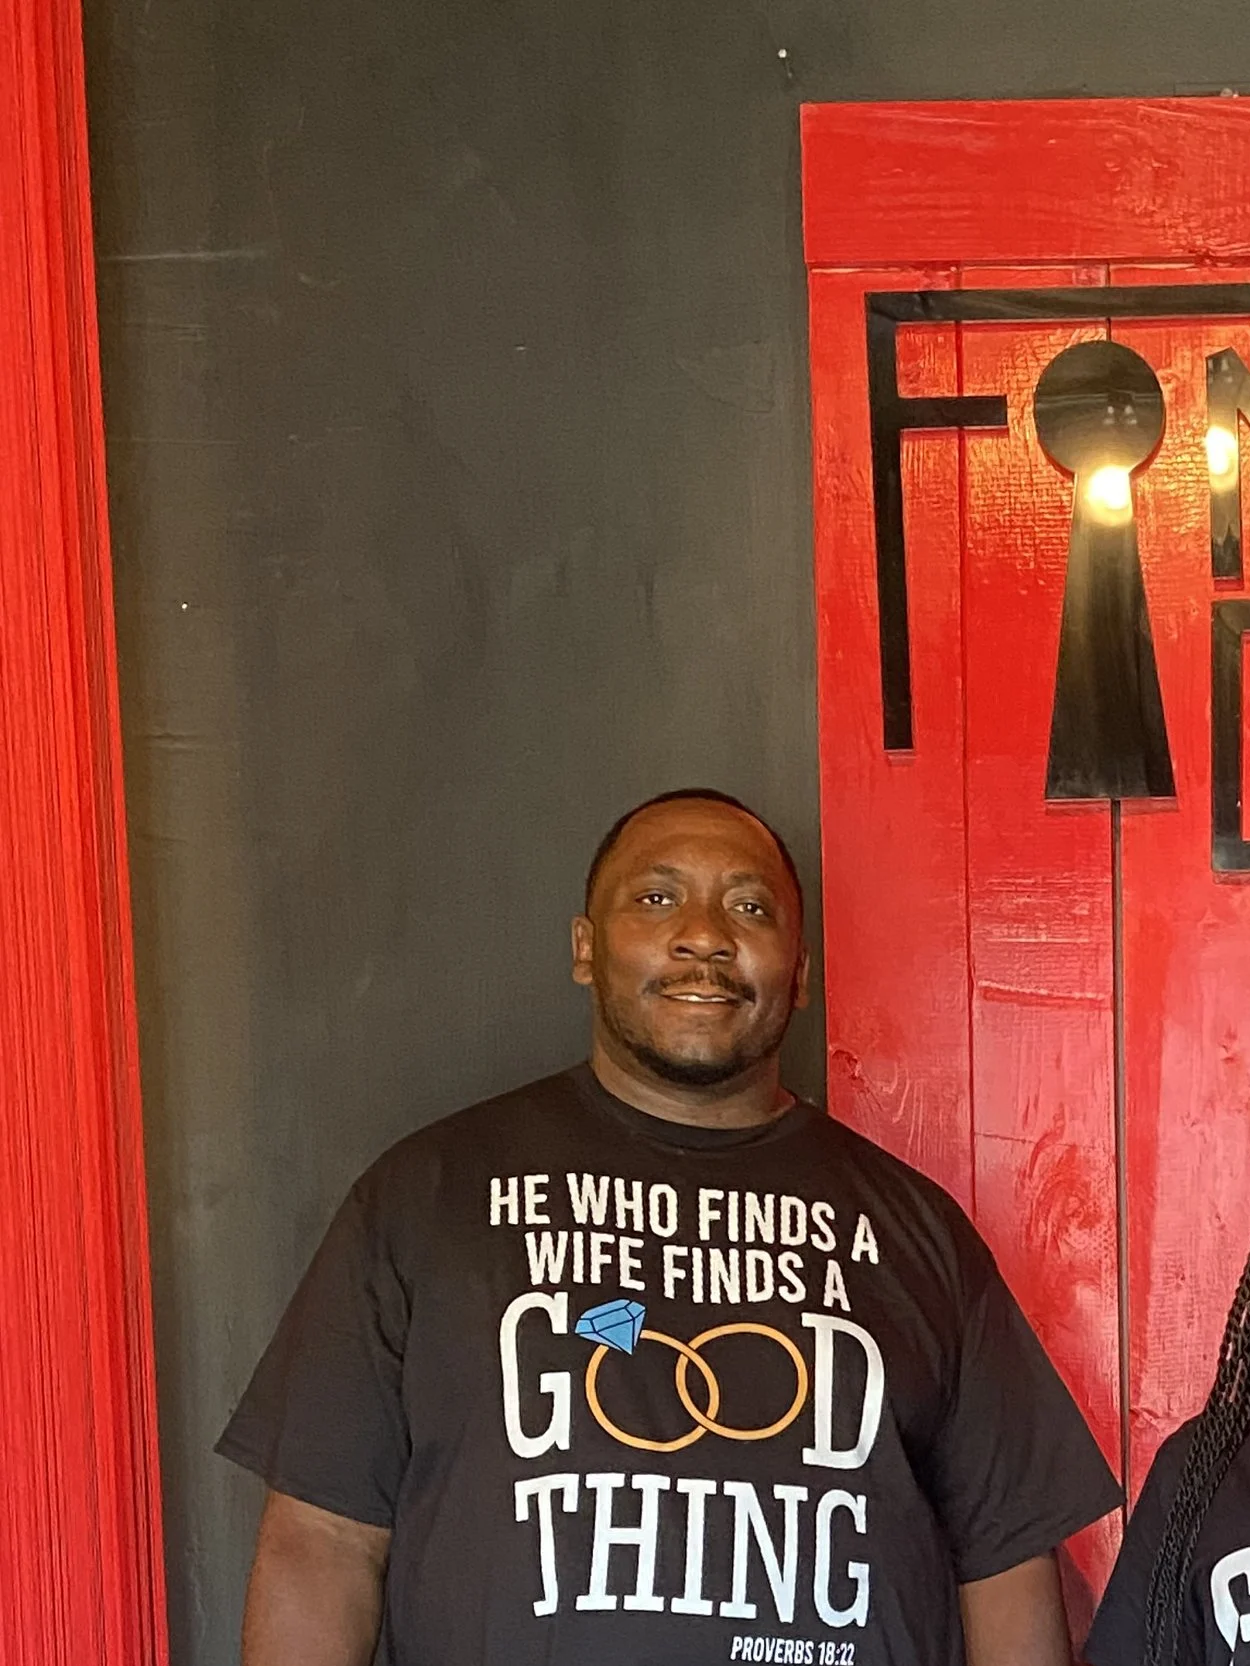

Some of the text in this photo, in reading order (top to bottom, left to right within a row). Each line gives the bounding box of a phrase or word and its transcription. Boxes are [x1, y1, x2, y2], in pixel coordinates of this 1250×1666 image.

[489, 1172, 879, 1264] HE WHO FINDS A
[525, 1231, 851, 1312] WIFE FINDS A
[499, 1291, 885, 1470] GOOD
[514, 1473, 870, 1628] THING
[730, 1636, 855, 1666] PROVERBS 18:22
